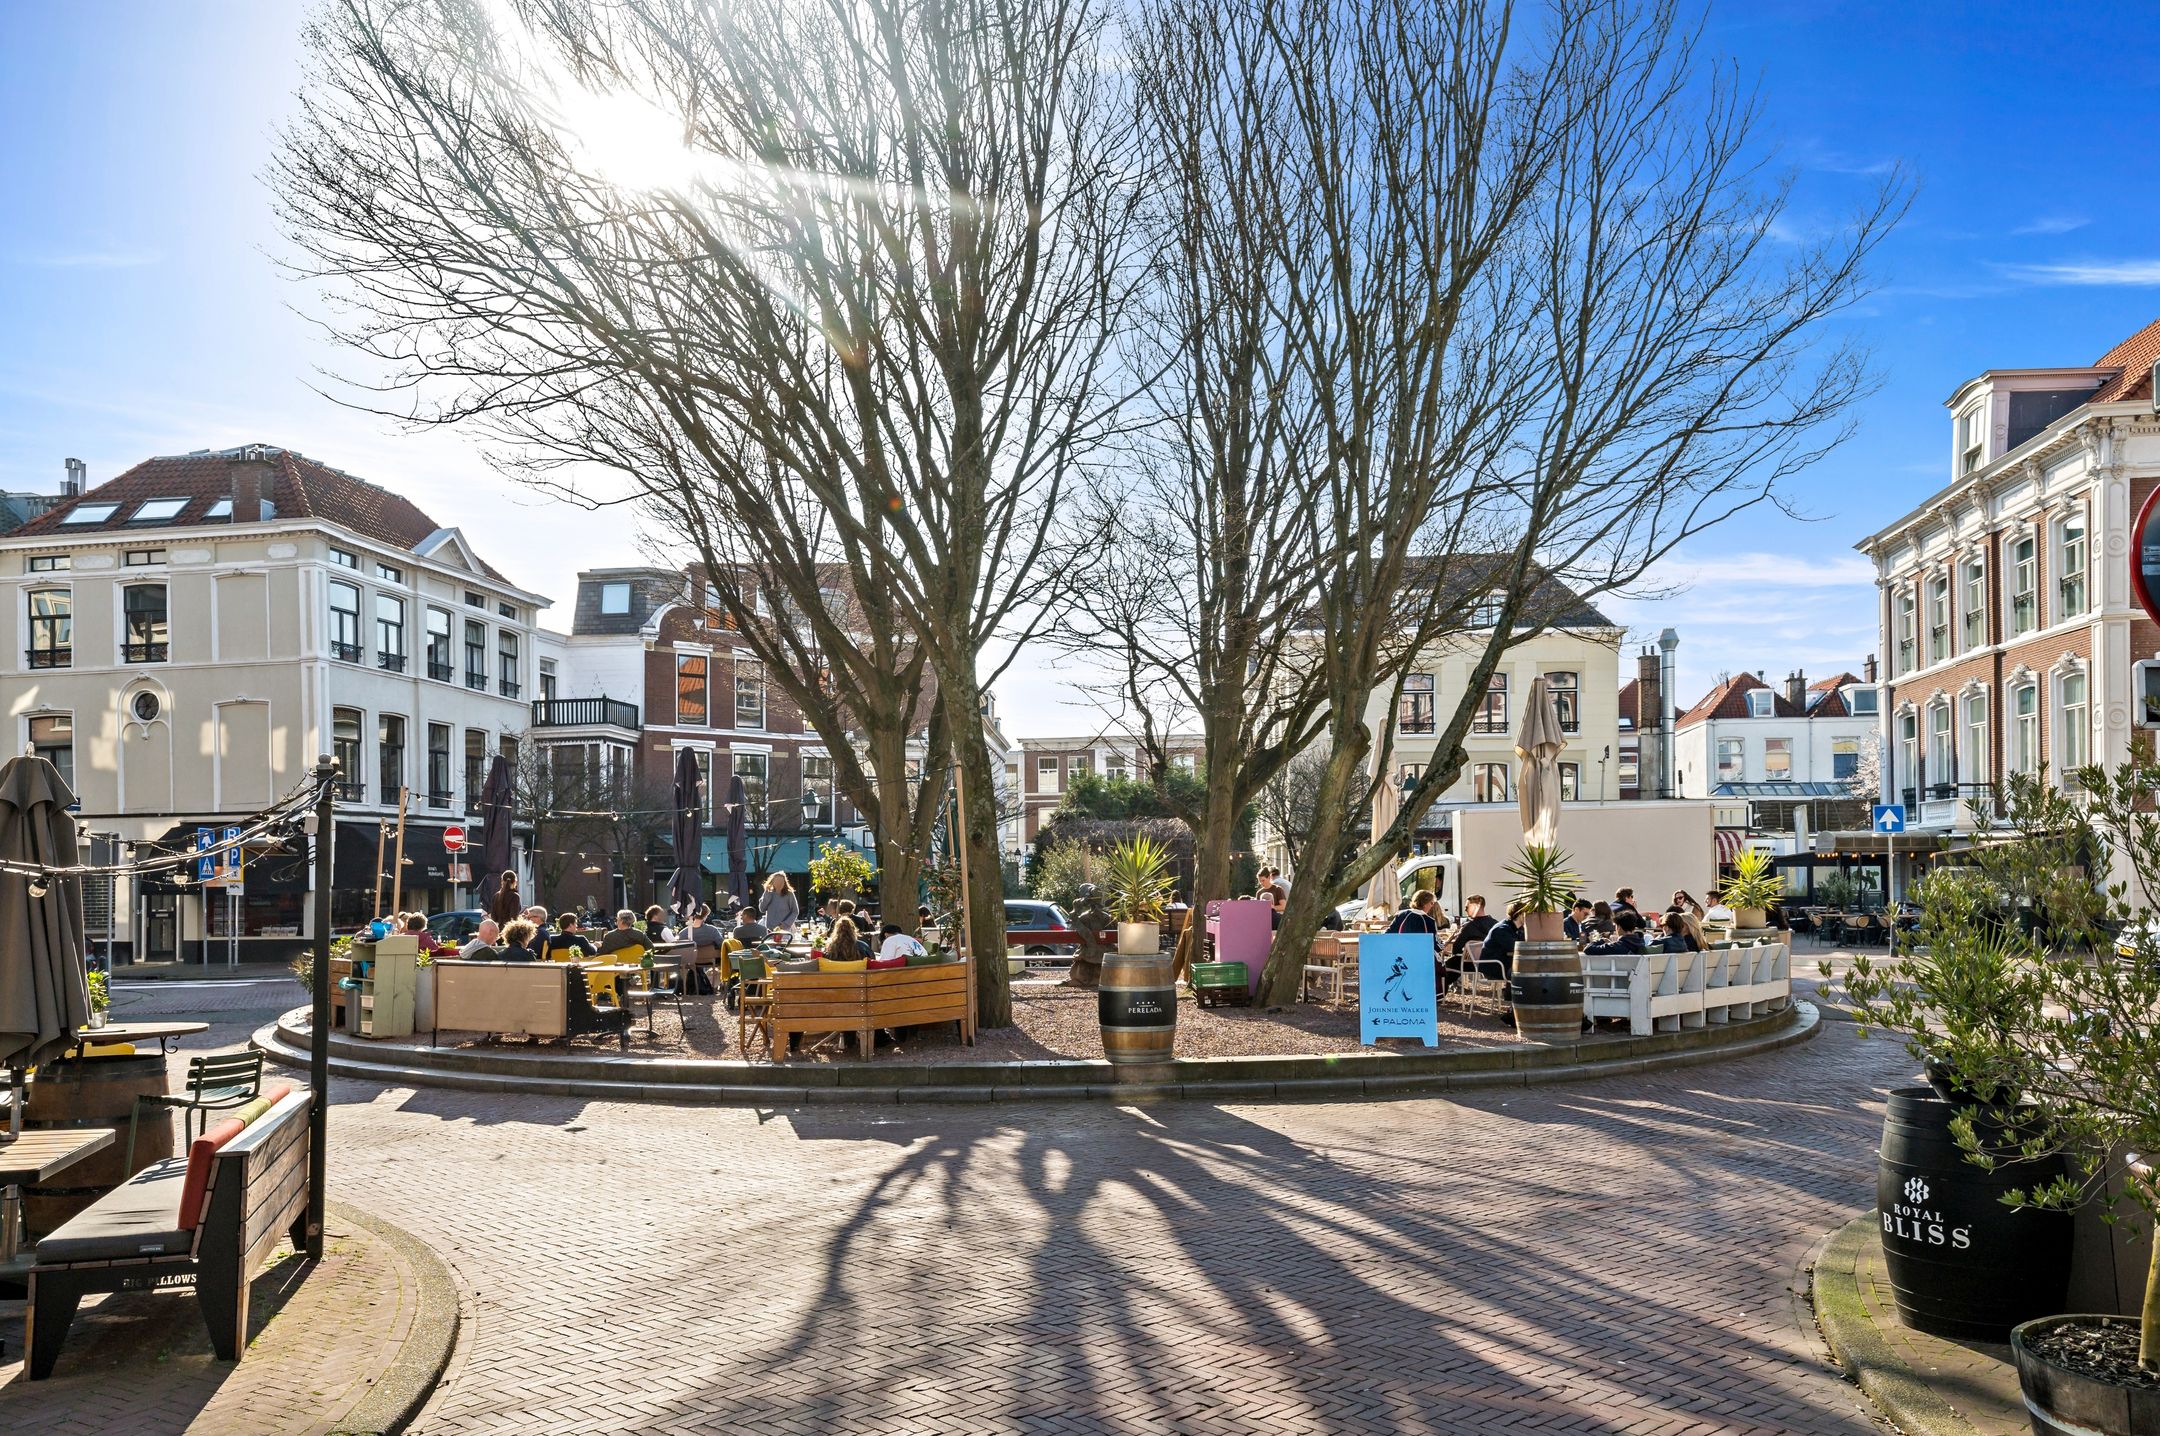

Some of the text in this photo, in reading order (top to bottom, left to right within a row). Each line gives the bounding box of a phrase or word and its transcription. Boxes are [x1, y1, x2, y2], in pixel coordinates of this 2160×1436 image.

[231, 848, 239, 865] P
[1383, 1018, 1426, 1026] PALOMA
[1893, 1203, 1944, 1223] ROYAL
[1882, 1211, 1971, 1249] BLISS
